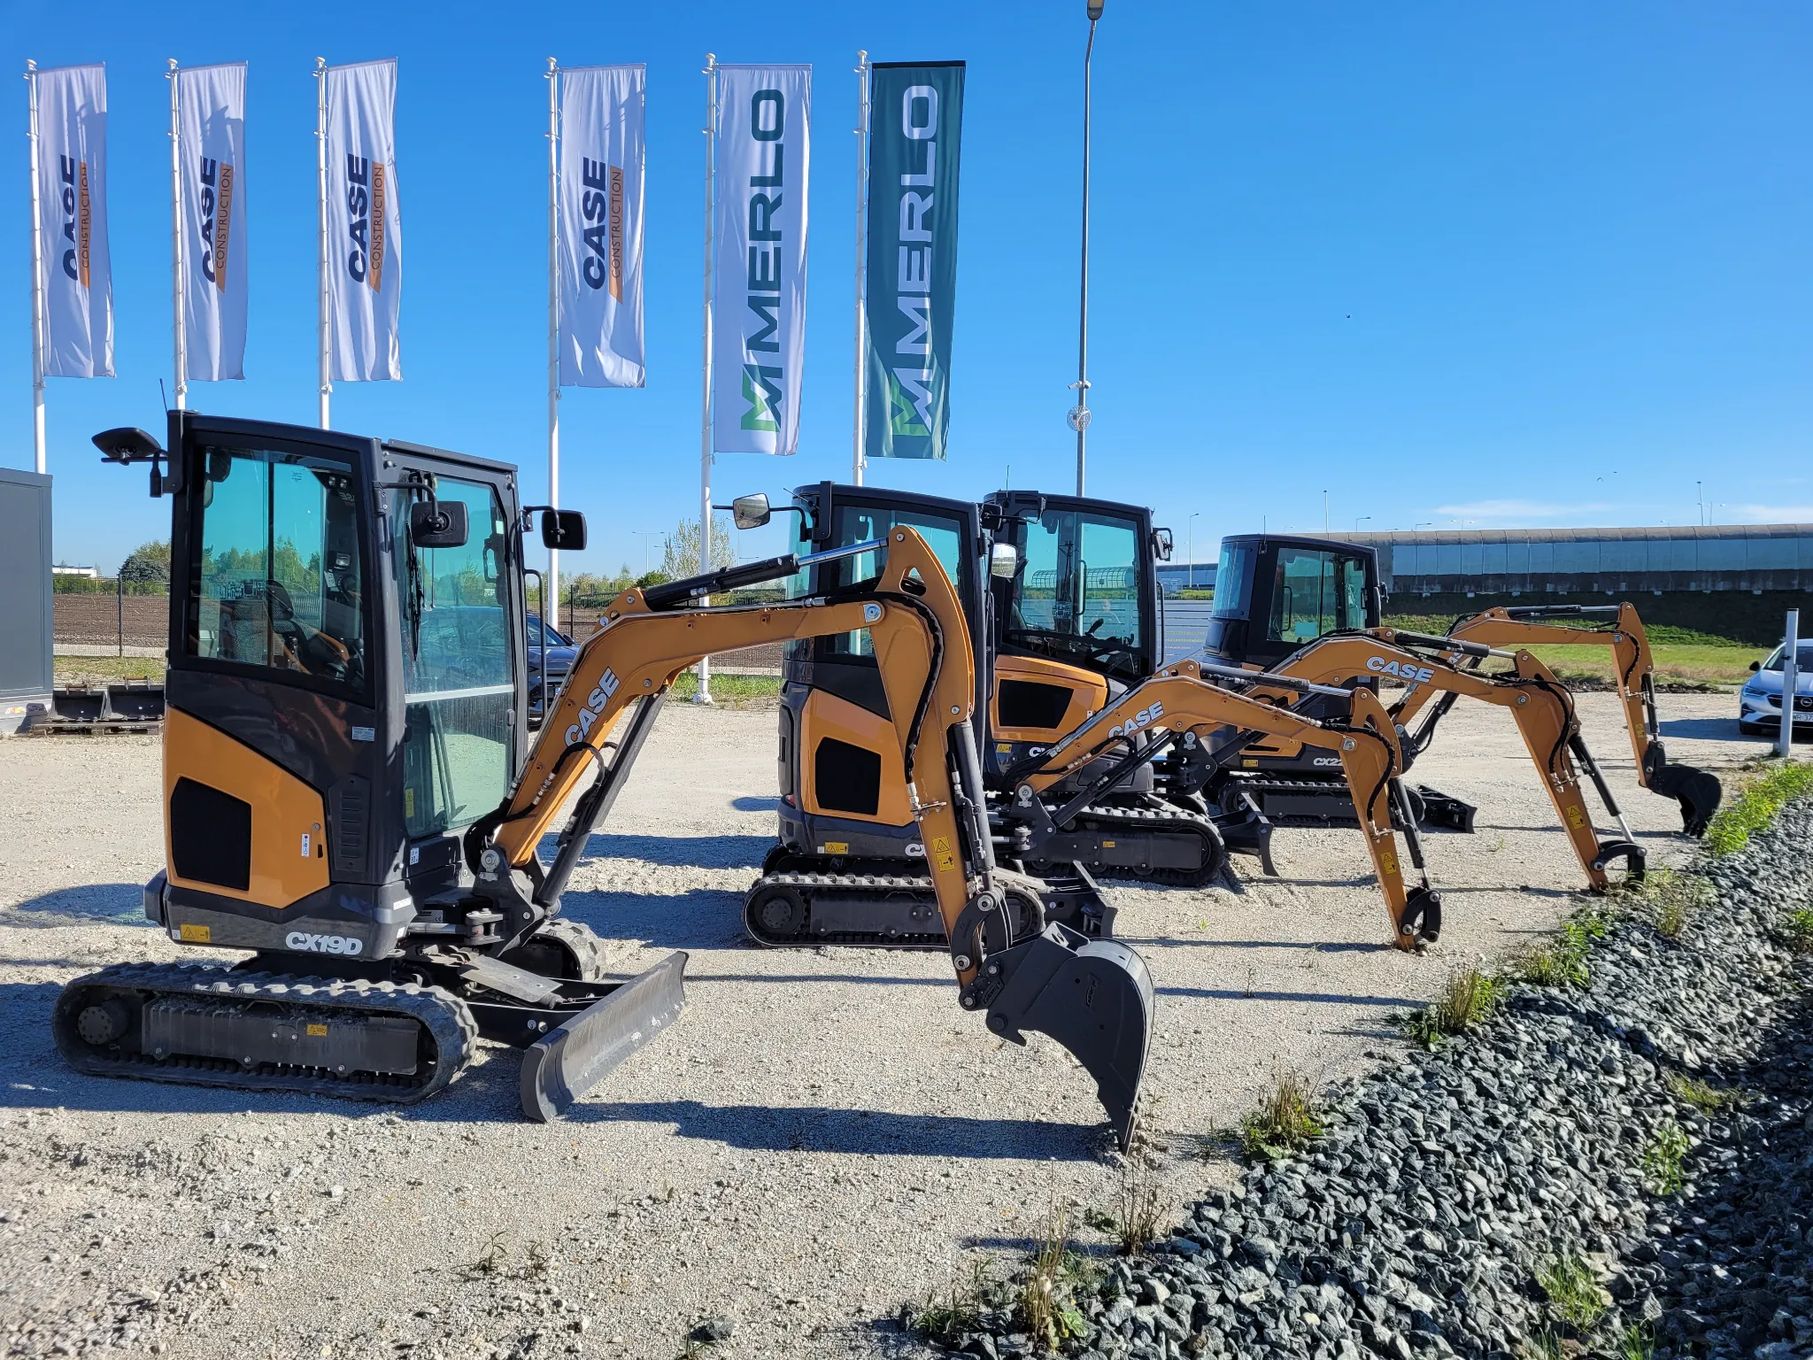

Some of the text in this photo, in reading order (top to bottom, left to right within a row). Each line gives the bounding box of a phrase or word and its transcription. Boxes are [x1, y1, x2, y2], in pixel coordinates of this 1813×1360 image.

[200, 155, 216, 282] CASE
[216, 168, 231, 269] CONSTRUCTION
[347, 153, 367, 282] CASE
[371, 167, 383, 270] CONSTRUCTION
[583, 157, 606, 289] CASE
[611, 171, 621, 278] CONSTRUCTION
[747, 89, 784, 353] MERLO
[896, 85, 938, 354] MERLO
[564, 666, 621, 746] CASE
[1108, 700, 1164, 738] CASE
[1366, 656, 1435, 682] CASE
[285, 931, 363, 955] CX19D
